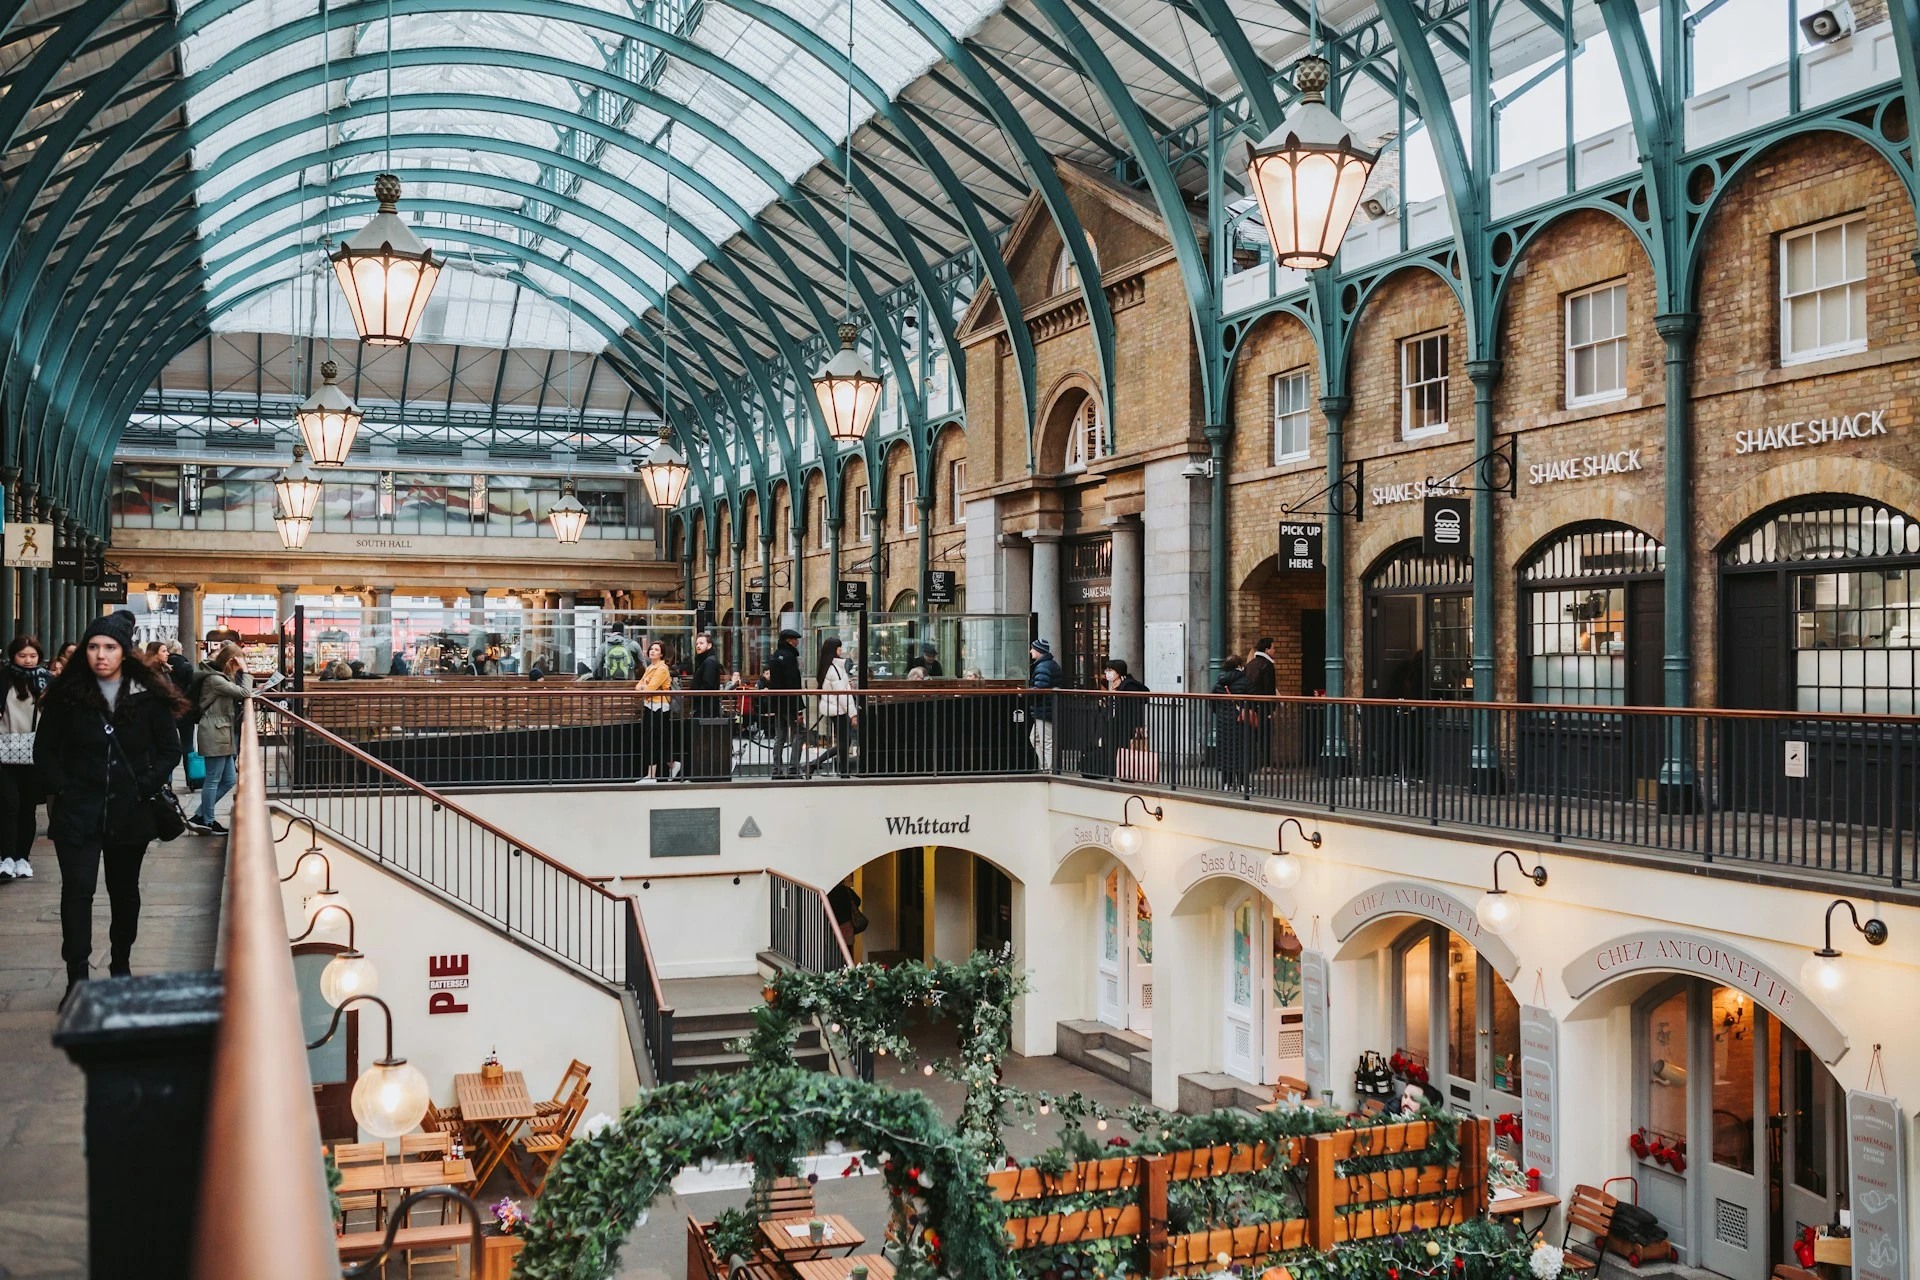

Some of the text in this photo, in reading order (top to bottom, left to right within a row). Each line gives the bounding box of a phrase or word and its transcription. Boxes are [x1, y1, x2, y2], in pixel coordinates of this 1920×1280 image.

[1735, 409, 1888, 454] SHAKE SHACK
[1529, 449, 1642, 485] SHAKE SHACK
[1372, 476, 1460, 506] SHAKE SHACK
[1281, 525, 1321, 536] PICK UP
[388, 540, 412, 548] HALL
[1288, 559, 1314, 569] HERE
[1082, 587, 1100, 598] SHAKE
[885, 814, 970, 836] Whittard
[1074, 827, 1093, 844] Sass
[1094, 824, 1101, 843] &
[1200, 851, 1269, 888] Sass & Belle
[1354, 889, 1488, 942] CHEZ ANTOINETTE
[1596, 940, 1795, 1013] CHEZ ANTOINETTE
[430, 980, 468, 989] BATTERSEA
[1526, 1087, 1550, 1102] LUNCH
[1527, 1108, 1550, 1122] TEATIME
[1527, 1128, 1551, 1143] APERO
[1853, 1135, 1894, 1151] HOMEMADE
[1526, 1149, 1551, 1164] DINNER
[1863, 1146, 1885, 1157] FRENCH
[1857, 1174, 1887, 1188] BREAKFAST
[1857, 1219, 1878, 1229] COFFEE
[1859, 1226, 1869, 1235] TEA
